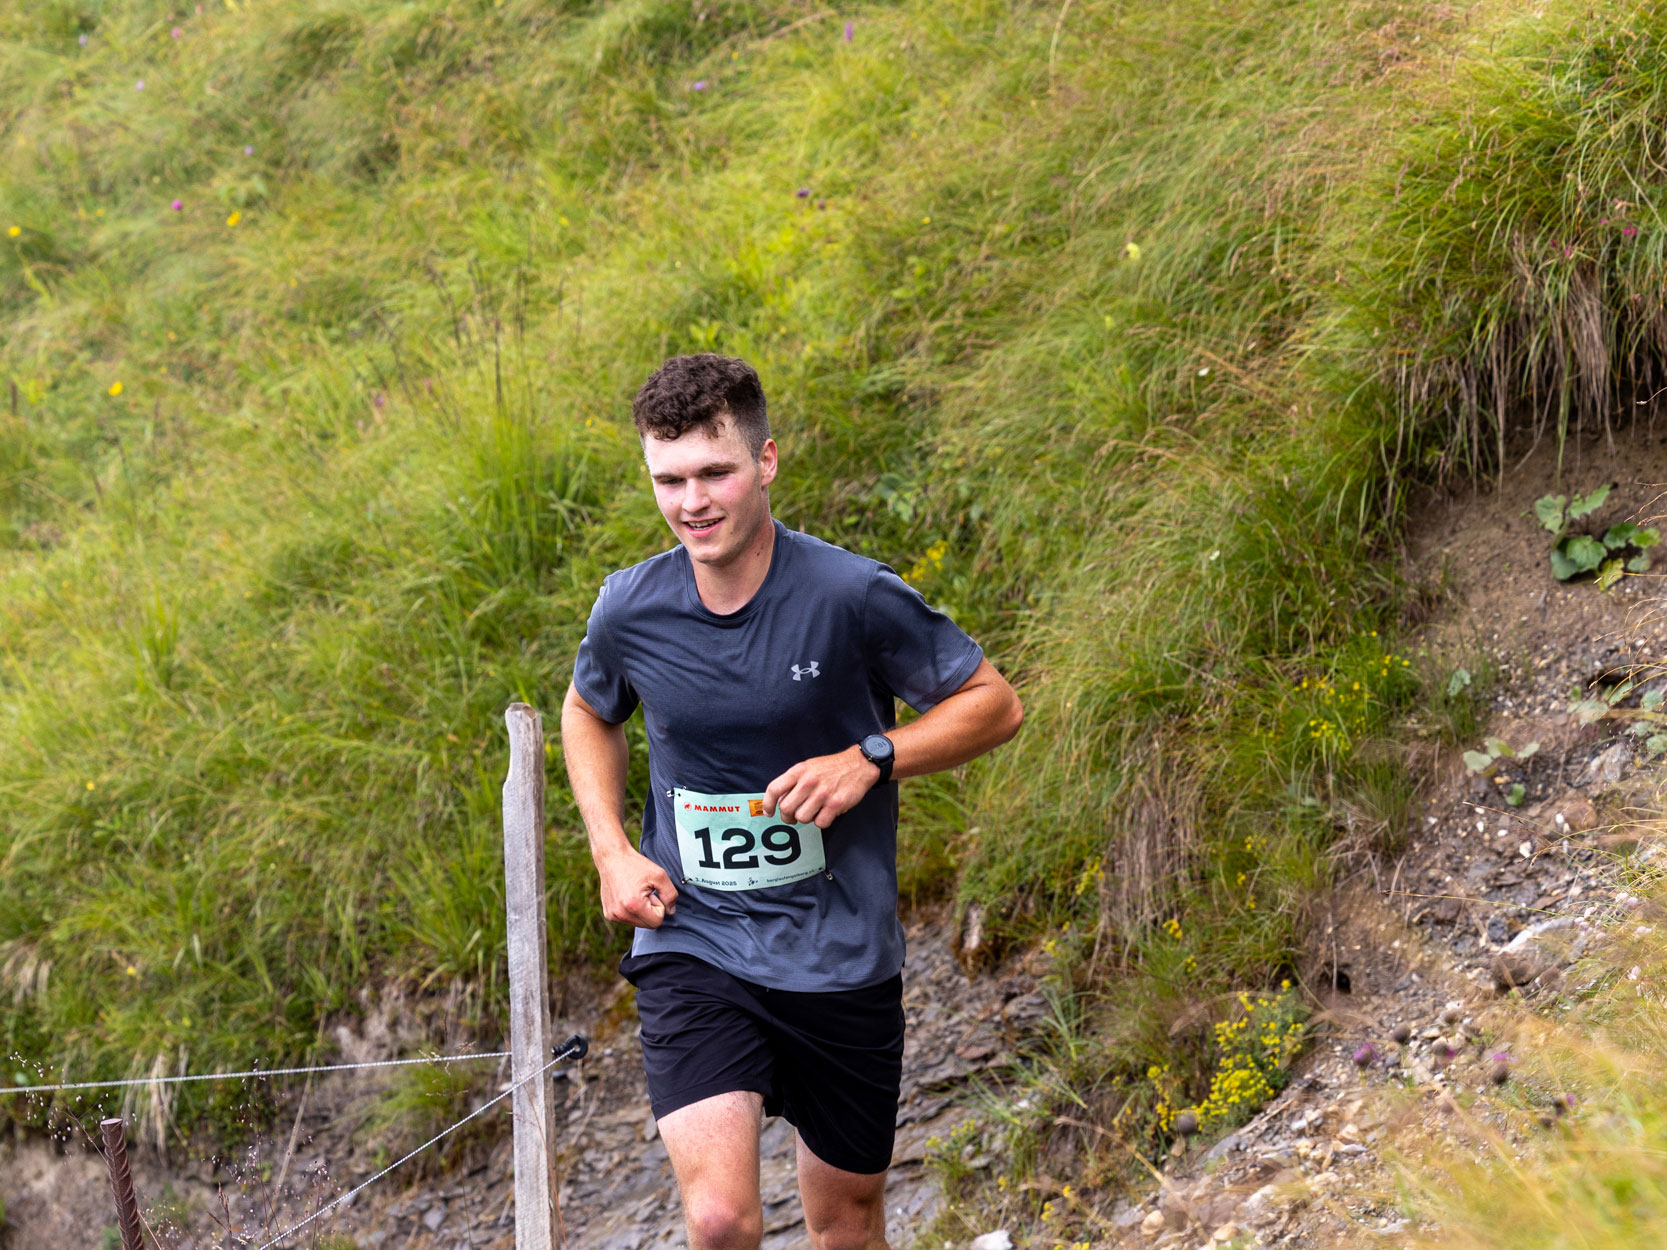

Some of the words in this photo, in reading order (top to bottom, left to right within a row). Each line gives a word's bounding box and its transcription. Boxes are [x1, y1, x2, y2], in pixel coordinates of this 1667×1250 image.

[694, 804, 741, 813] MAMMUT
[694, 824, 802, 870] 129
[701, 878, 721, 886] August
